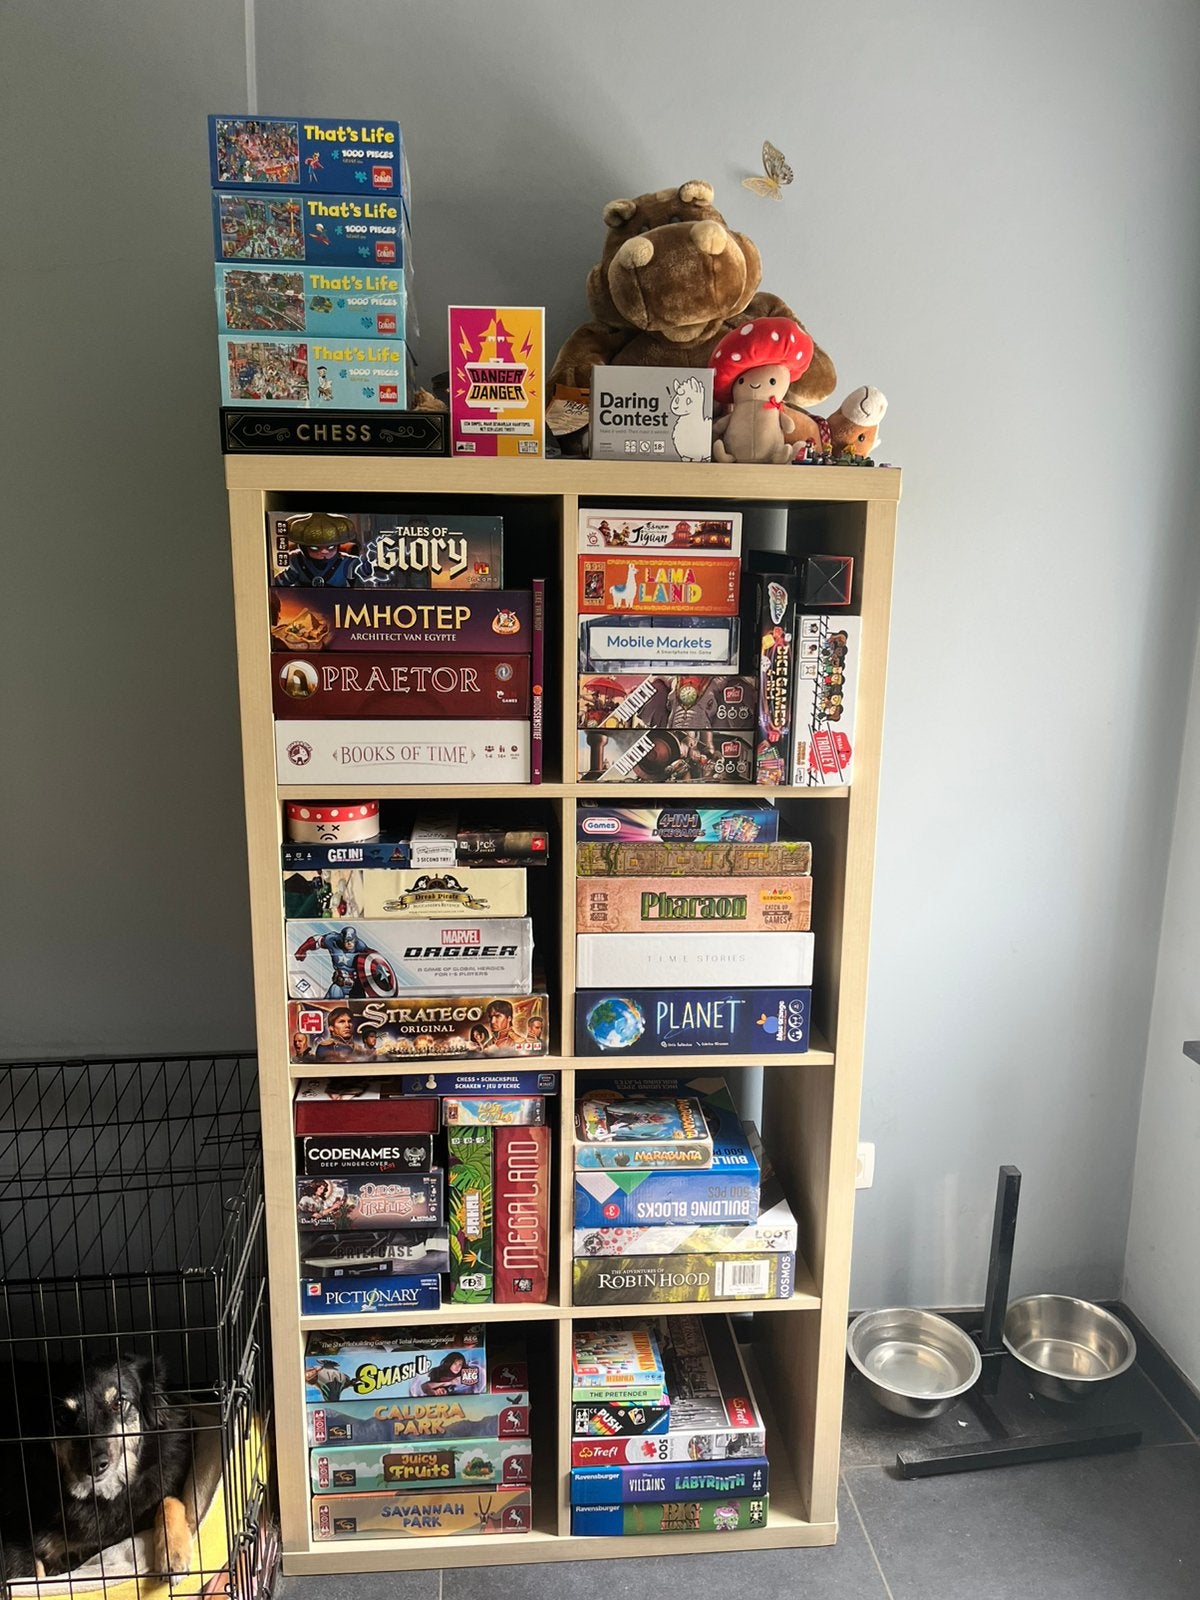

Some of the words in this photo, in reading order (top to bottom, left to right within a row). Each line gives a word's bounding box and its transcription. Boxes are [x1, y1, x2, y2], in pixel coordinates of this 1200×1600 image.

[304, 125, 358, 142] That's
[362, 127, 395, 143] Life
[342, 149, 364, 158] 1000
[366, 150, 394, 159] PIECES
[307, 201, 361, 217] That's
[365, 203, 397, 219] Life
[345, 225, 367, 233] 1000
[369, 225, 396, 234] PIECES
[310, 274, 362, 290] That's
[366, 277, 398, 291] Life
[347, 298, 369, 306] 1000
[371, 298, 397, 306] PIECES
[378, 321, 396, 330] Goliath
[312, 346, 365, 361] That's
[368, 349, 399, 363] Life
[349, 369, 371, 377] 1000
[372, 369, 399, 377] PIECES
[470, 369, 524, 384] DANGER
[380, 391, 397, 400] Goliath
[470, 385, 525, 400] DANGER
[600, 392, 659, 412] Daring
[599, 410, 669, 427] Contest
[296, 424, 372, 441] CHESS
[395, 526, 430, 537] TALES
[432, 527, 448, 537] OF
[630, 526, 668, 546] Jiguan
[376, 534, 469, 581] Glory
[645, 567, 696, 583] LAMA
[639, 583, 702, 603] LAND
[333, 603, 472, 630] IMHOTEP
[350, 632, 402, 642] ARCHITECT
[403, 633, 422, 642] VAN
[424, 633, 456, 642] EGYPTE
[607, 635, 655, 649] Mobile
[656, 636, 712, 649] Markets
[775, 645, 789, 678] DICE
[321, 665, 481, 693] PRAETOR
[617, 680, 657, 723] UNLOCK!
[773, 678, 789, 727] GAMES
[835, 735, 844, 751] TRIAL
[341, 745, 396, 765] BOOKS
[401, 745, 420, 762] OF
[426, 745, 469, 765] TIME
[615, 734, 656, 776] UNLOCK!
[816, 735, 836, 768] TROLLEY
[587, 822, 616, 830] Games
[659, 813, 699, 828] 4-IN-1
[328, 849, 348, 863] GET
[348, 848, 364, 861] IN!
[641, 891, 748, 920] Pharaon
[764, 914, 790, 925] GAMES
[442, 929, 479, 944] MARVEL
[697, 955, 746, 963] STORIES
[357, 1004, 483, 1034] STRATEGO
[656, 1000, 741, 1034] PLANET
[777, 1000, 786, 1026] orange
[400, 1024, 456, 1034] ORIGINAL
[477, 1101, 503, 1113] LOST
[478, 1111, 513, 1123] CITIES
[308, 1147, 400, 1160] CODENAMES
[634, 1149, 702, 1162] MARABUNTA
[707, 1186, 727, 1199] PCS
[503, 1141, 539, 1269] MEGALAND
[637, 1201, 687, 1218] BLOCKS
[691, 1200, 750, 1217] BUILDING
[754, 1229, 792, 1240] LOOT
[336, 1245, 413, 1259] BRIEFCASE
[598, 1274, 657, 1290] ROBIN
[659, 1272, 710, 1288] HOOD
[779, 1255, 791, 1299] KOSMOS
[325, 1287, 420, 1305] PICTIONARY
[354, 1362, 417, 1395] SMASH
[462, 1372, 478, 1382] AEG
[604, 1390, 648, 1398] PRETENDER
[373, 1402, 466, 1421] CALDERA
[735, 1407, 749, 1426] Trefl
[394, 1420, 447, 1436] PARK
[597, 1408, 623, 1433] PUSH
[591, 1446, 618, 1458] Trefl
[658, 1439, 669, 1460] 500
[389, 1463, 450, 1479] Fruits
[574, 1472, 619, 1481] Ravensburger
[629, 1477, 666, 1492] VILLAINS
[675, 1473, 746, 1491] LABYRINTH
[381, 1503, 465, 1518] SAVANNAH
[575, 1504, 620, 1512] Ravensburger
[661, 1502, 700, 1520] BIG
[403, 1516, 443, 1529] PARK
